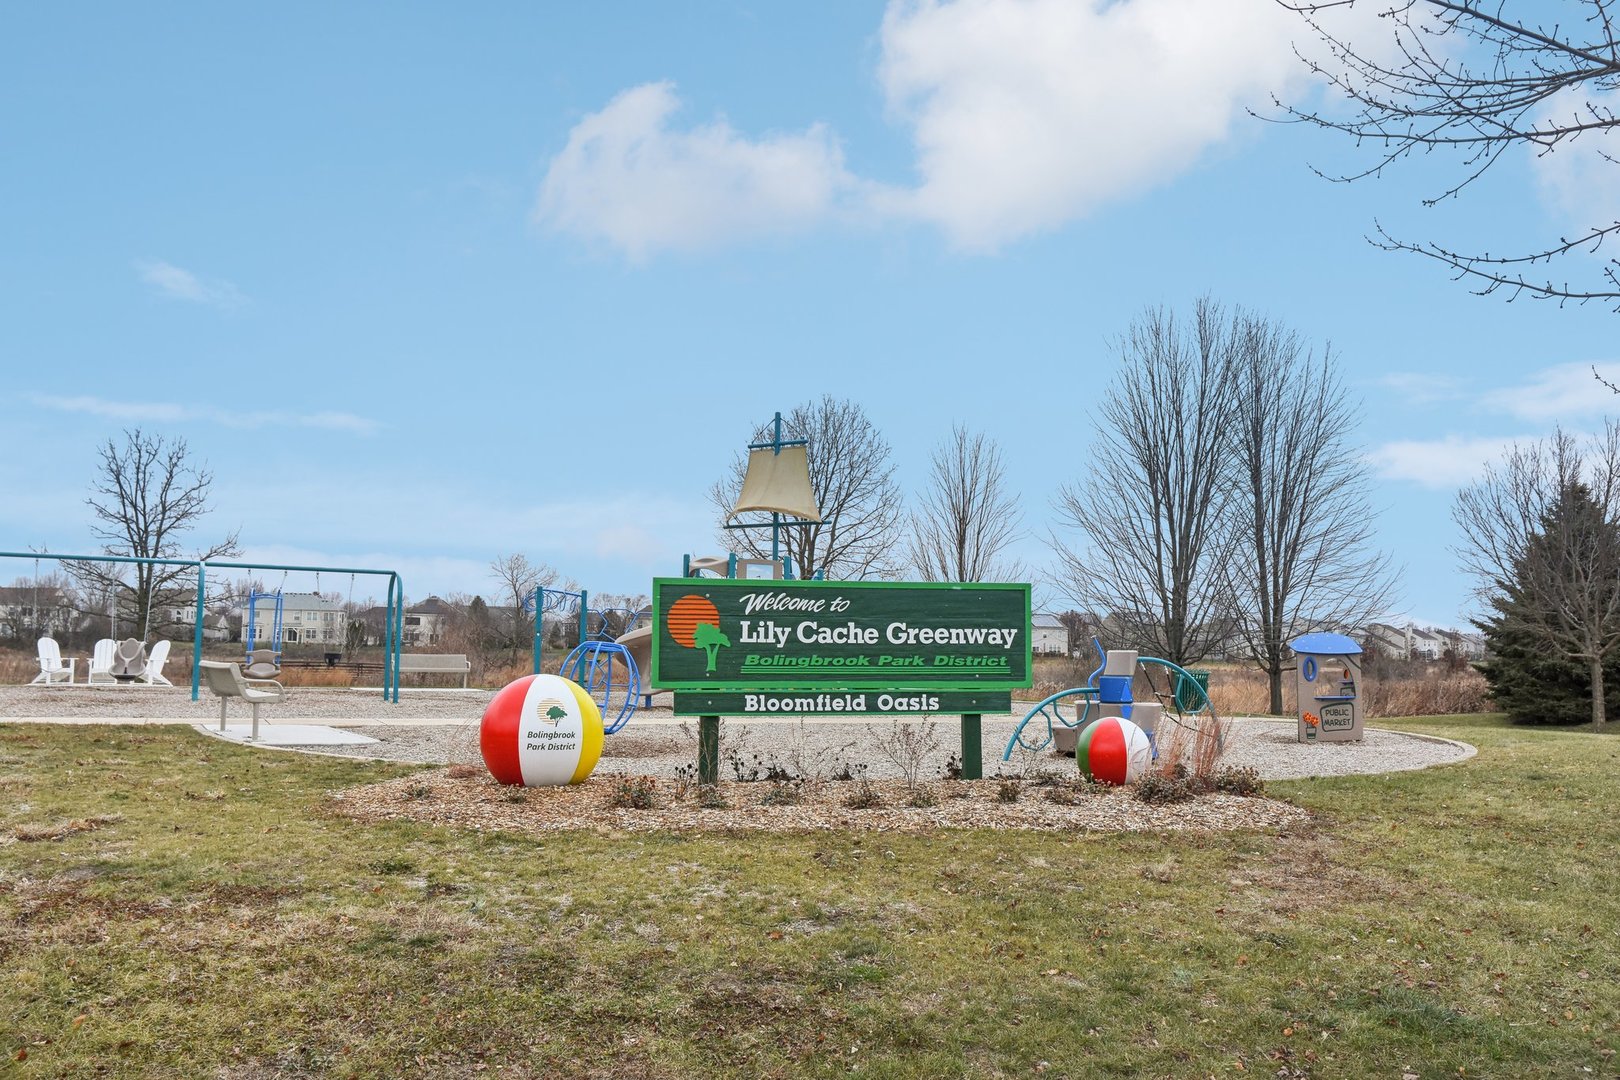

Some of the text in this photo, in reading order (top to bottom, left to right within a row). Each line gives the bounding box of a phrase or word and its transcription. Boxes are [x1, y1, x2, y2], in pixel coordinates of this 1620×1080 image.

[739, 592, 850, 615] Welcome to
[740, 621, 1018, 649] Lily Cache Greenway
[745, 655, 1008, 667] Bolingbrook Park District
[744, 694, 940, 712] Bloomfield Oasis
[1325, 708, 1349, 717] PUBLIC
[1323, 718, 1350, 727] MARKET
[527, 731, 576, 740] Bolingbrook
[547, 743, 576, 751] District
